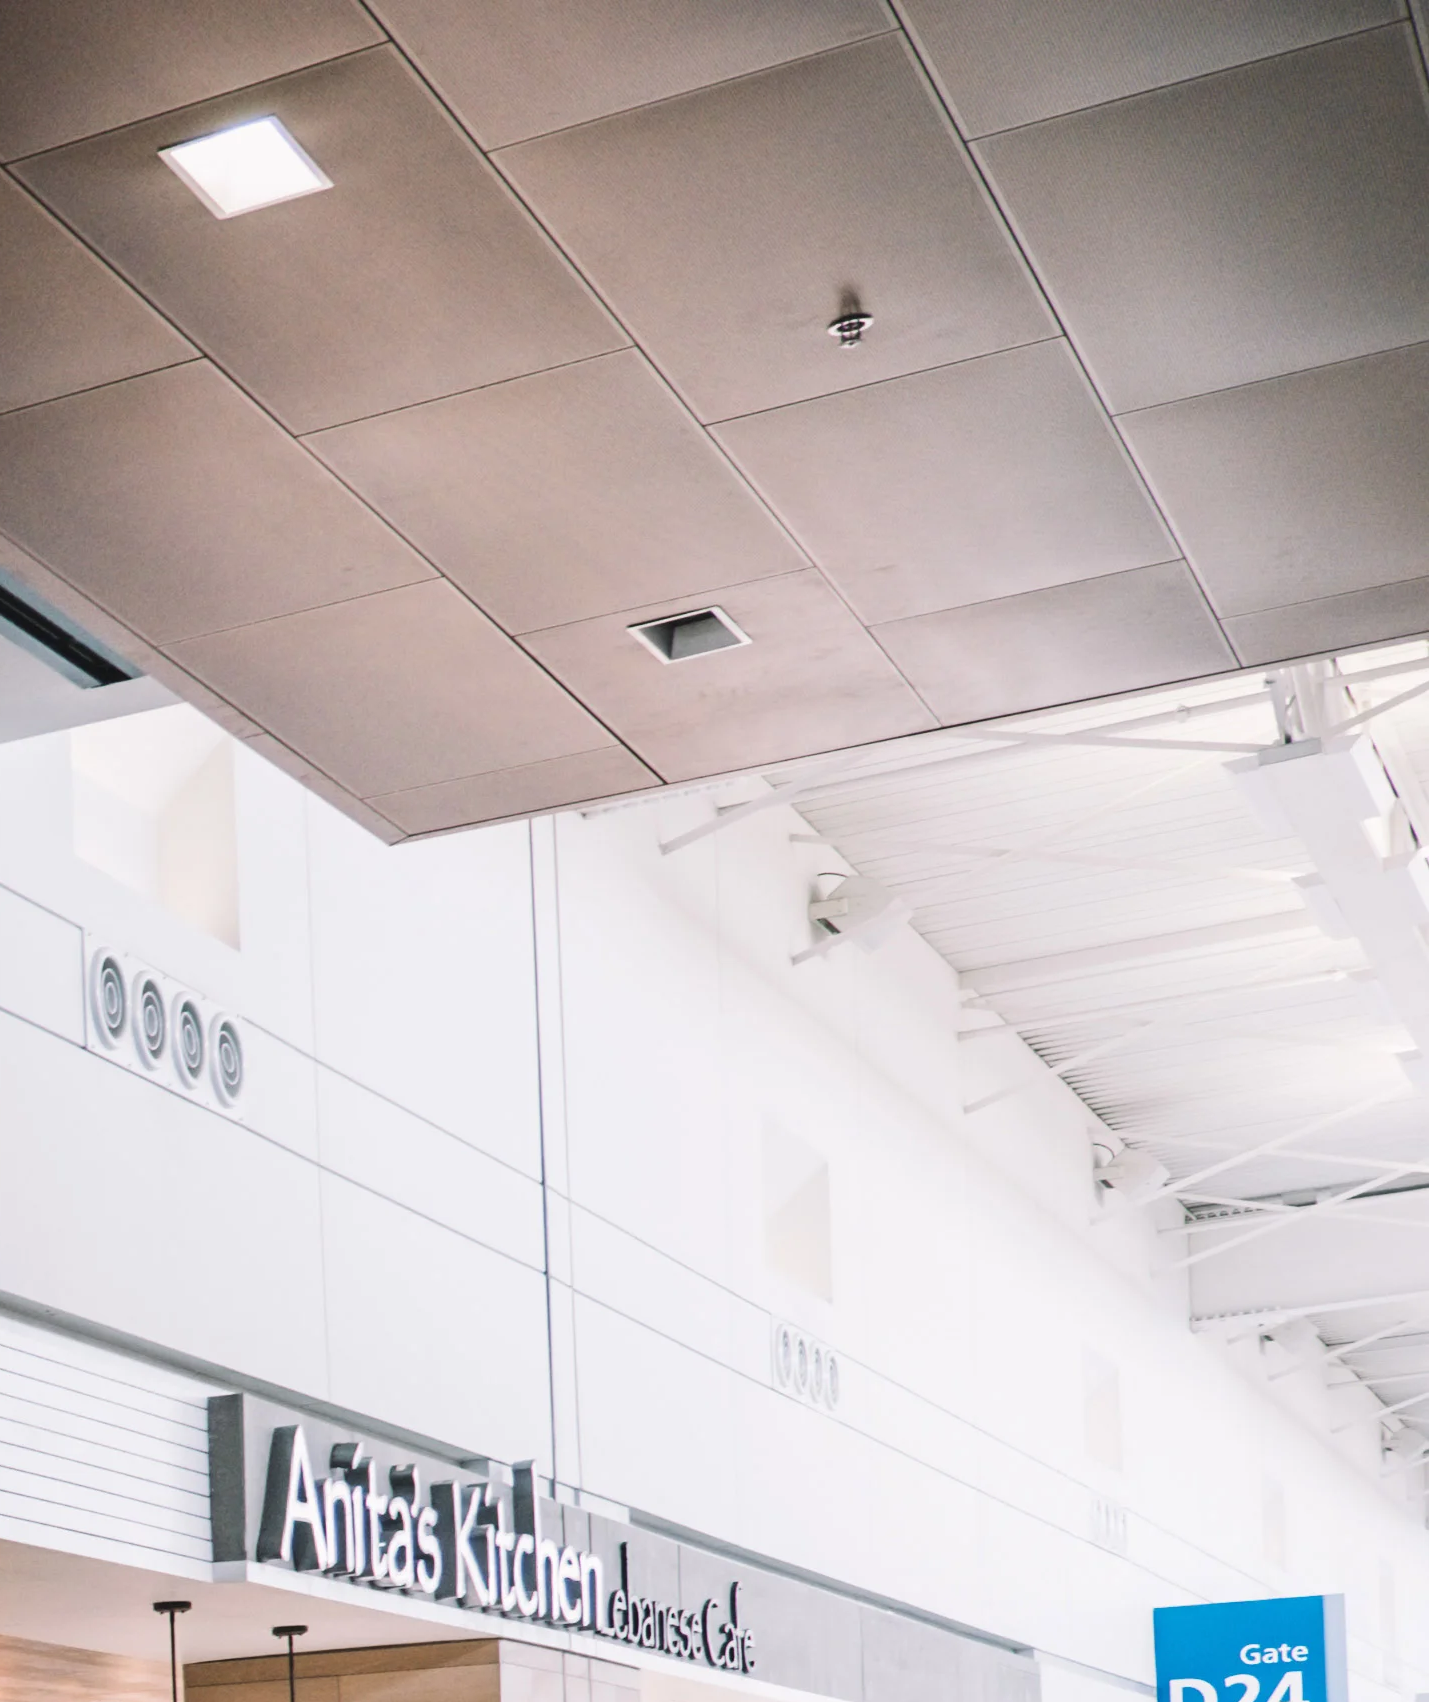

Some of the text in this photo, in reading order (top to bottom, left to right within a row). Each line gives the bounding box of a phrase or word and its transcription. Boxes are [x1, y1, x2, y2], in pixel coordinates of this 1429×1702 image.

[279, 1424, 444, 1596] Anita's
[451, 1459, 603, 1635] Kitchen
[596, 1542, 703, 1660] Lebanese
[1240, 1643, 1309, 1665] Gate
